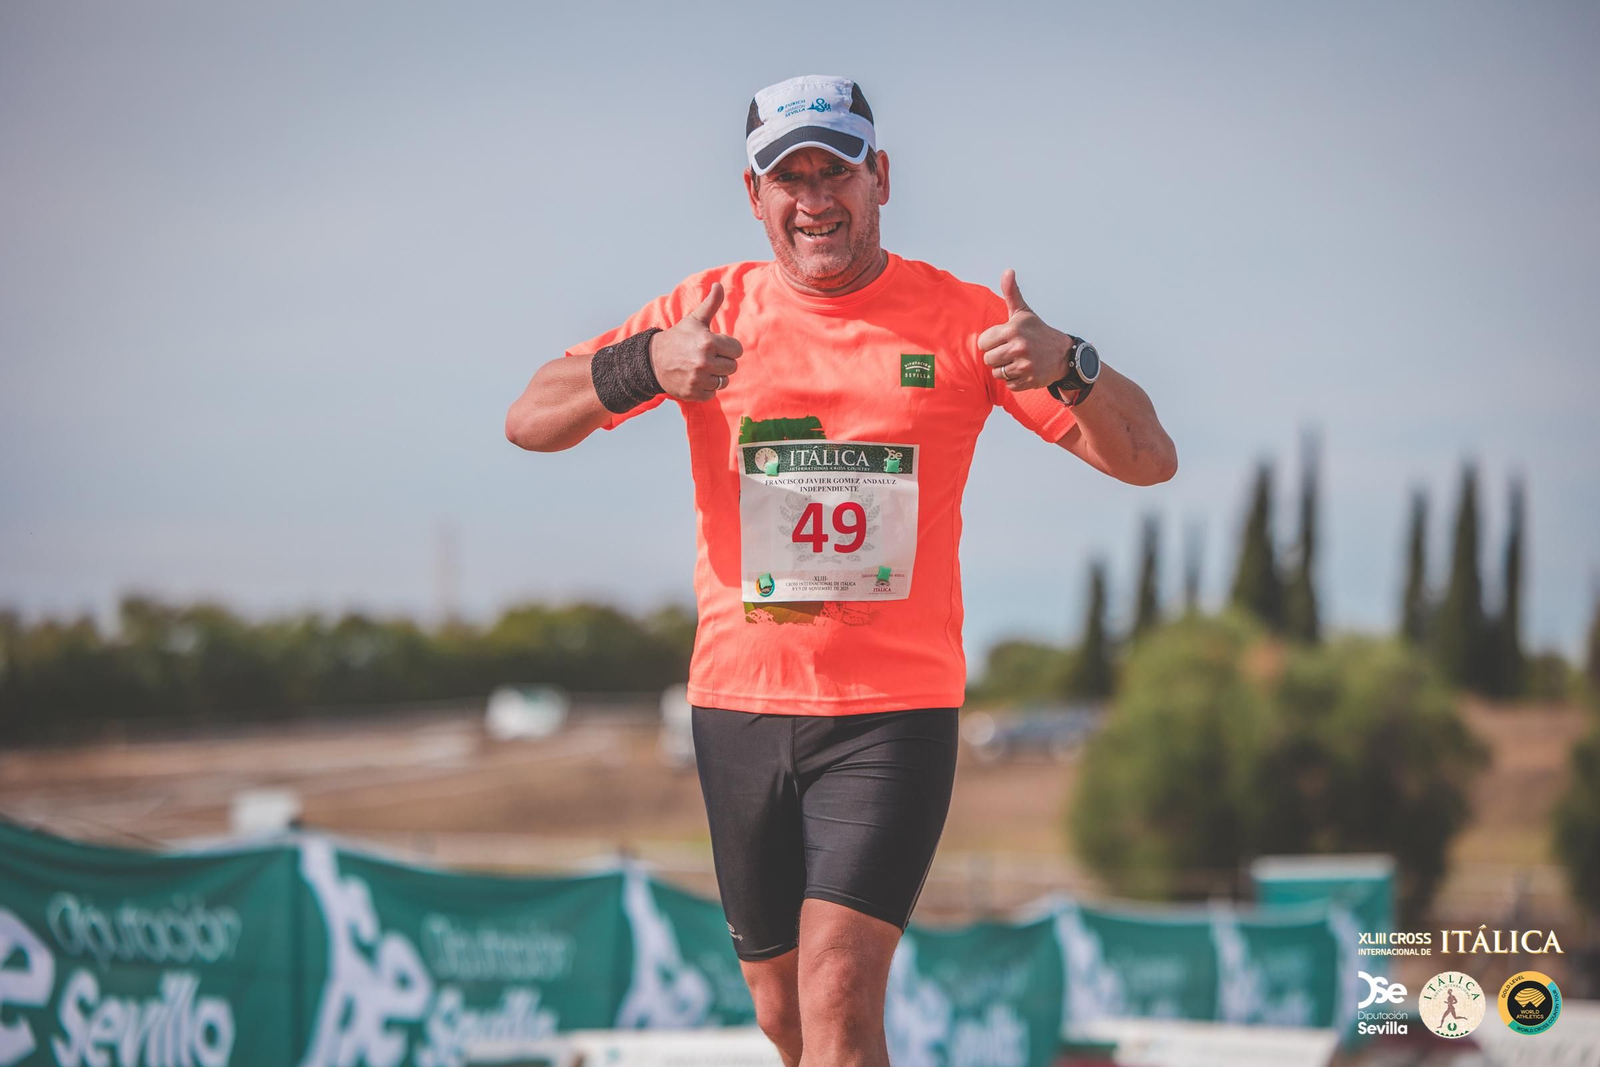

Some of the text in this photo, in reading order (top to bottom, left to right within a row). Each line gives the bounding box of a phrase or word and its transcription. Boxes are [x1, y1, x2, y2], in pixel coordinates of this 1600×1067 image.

[785, 108, 806, 118] SEVILLA
[789, 445, 870, 467] ITÁLICA
[791, 501, 867, 554] 49
